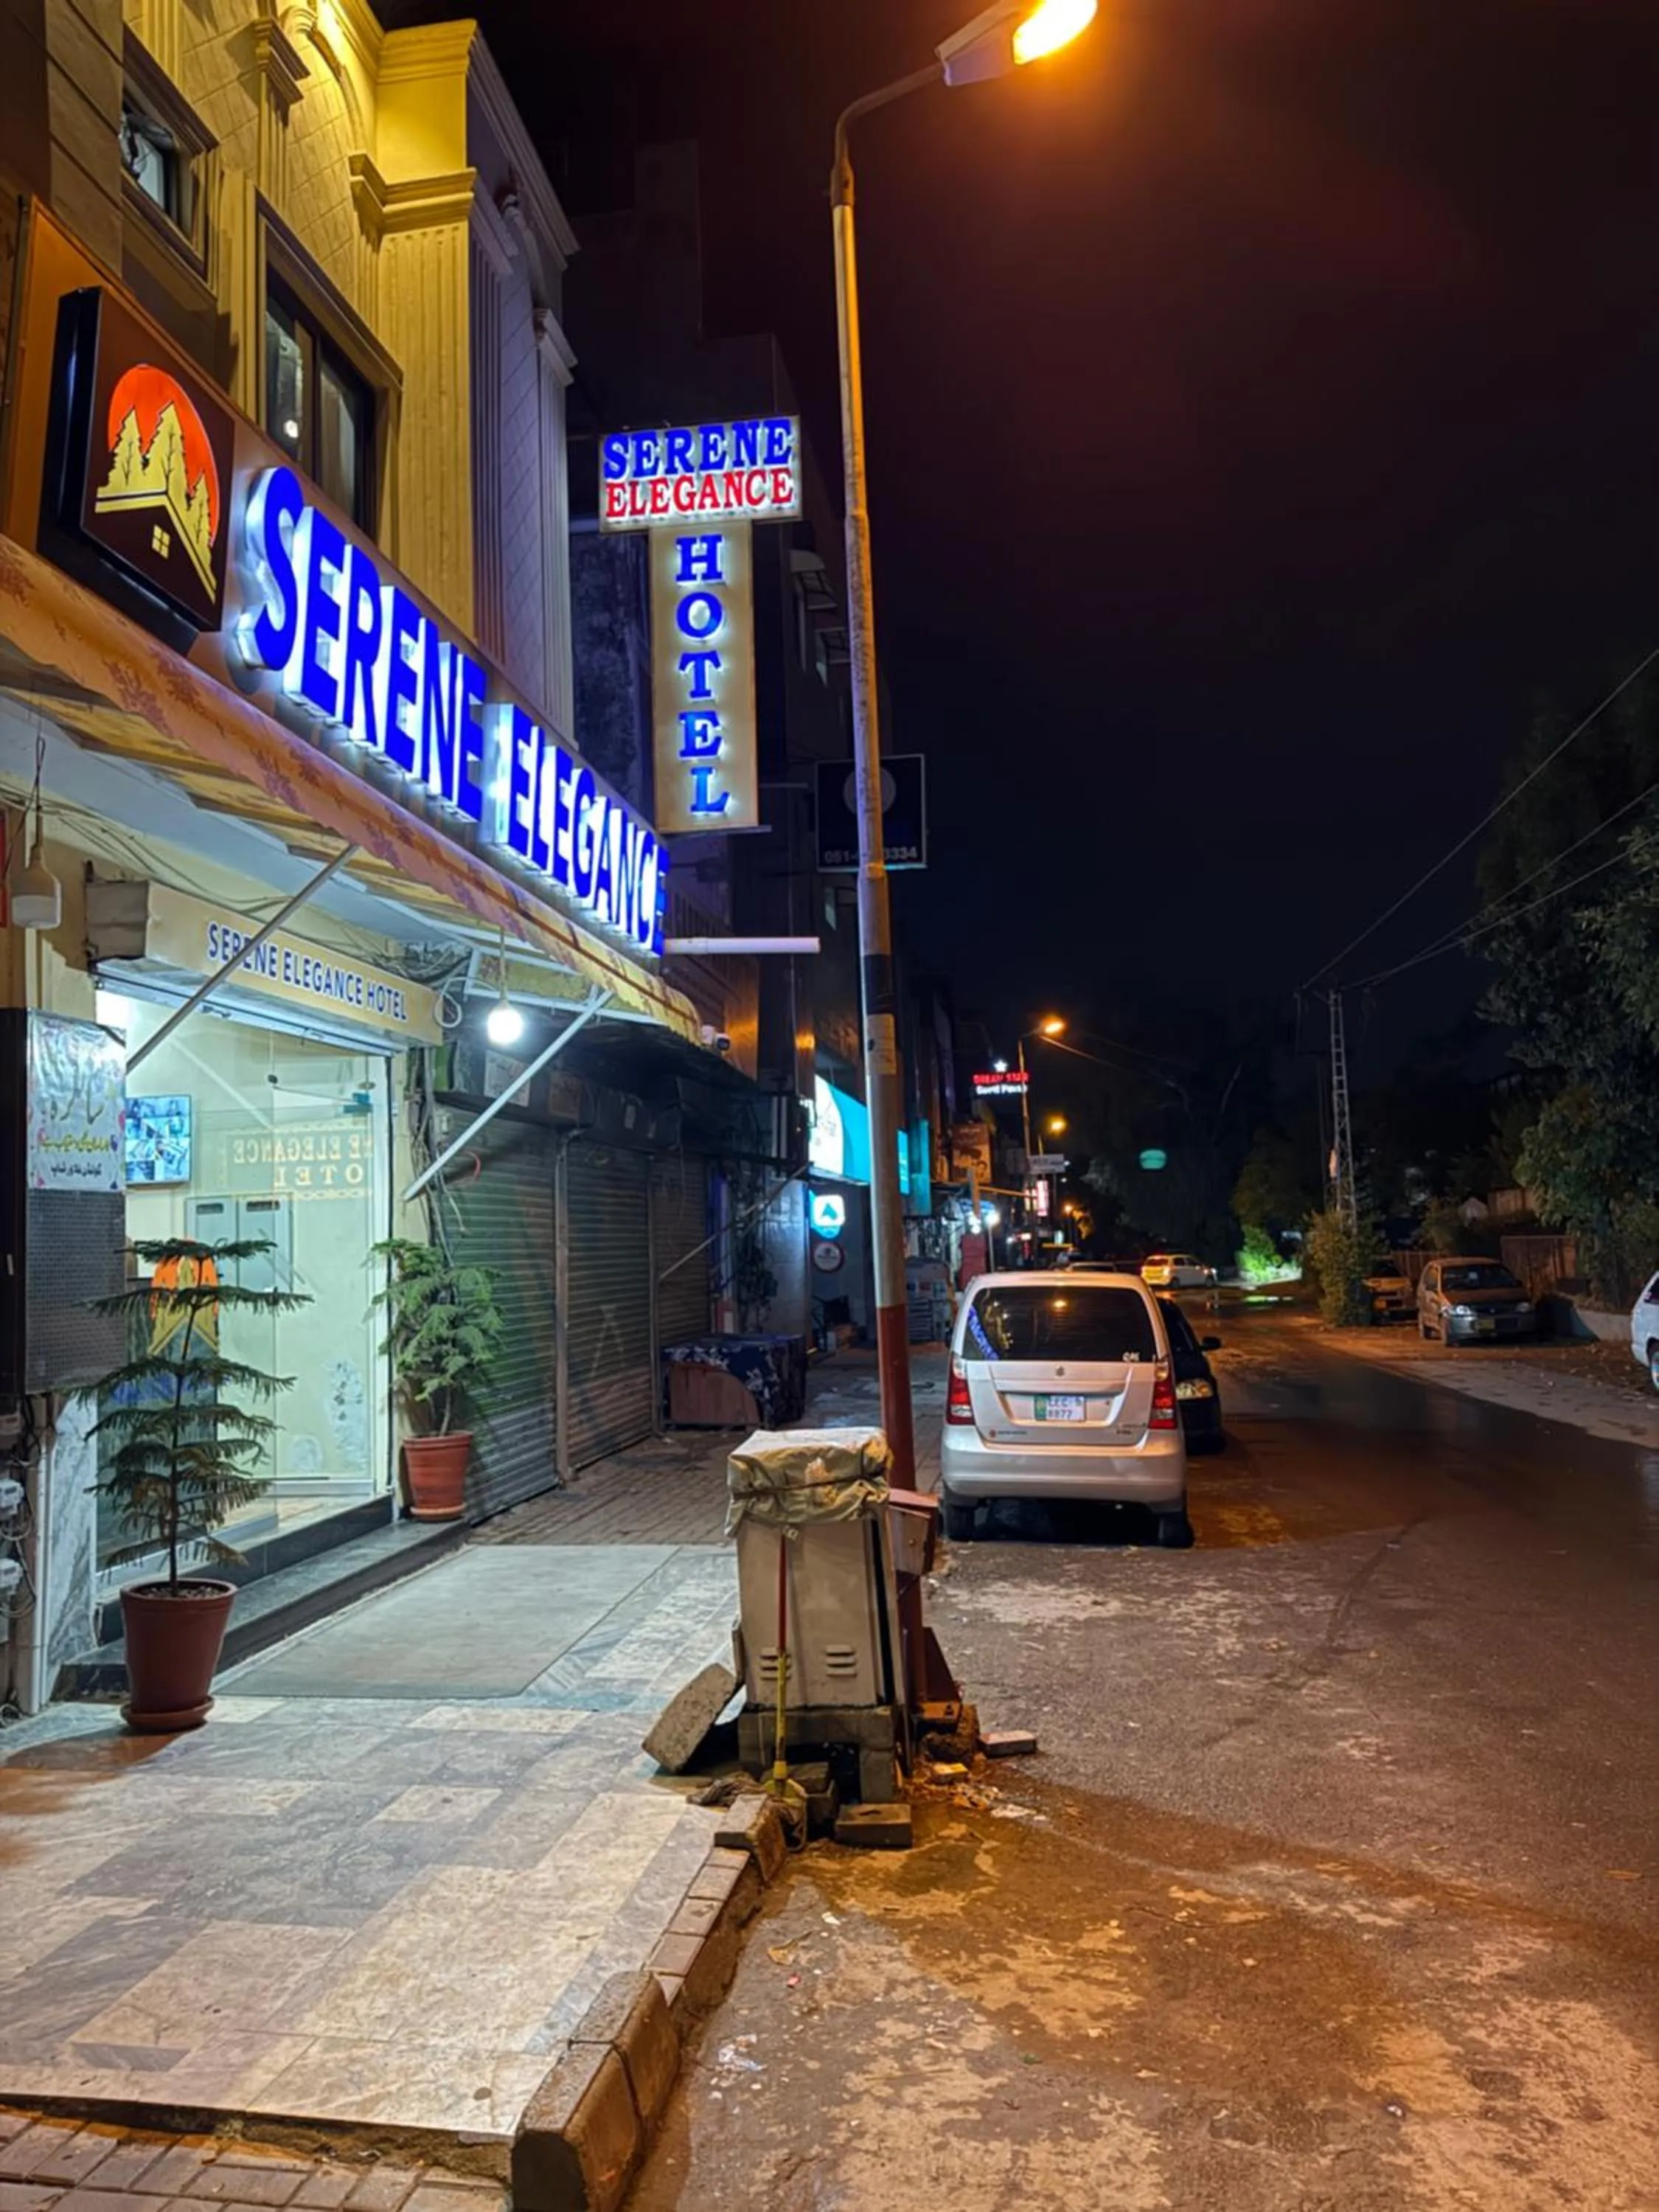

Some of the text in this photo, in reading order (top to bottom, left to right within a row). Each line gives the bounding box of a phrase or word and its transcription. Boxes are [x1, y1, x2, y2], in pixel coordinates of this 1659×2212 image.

[603, 418, 791, 480] SERENE
[605, 467, 793, 518] ELEGANCE
[675, 533, 731, 815] HOTEL
[251, 465, 670, 958] SERENE ELEGANCE
[283, 950, 364, 1006] ELEGANCE
[366, 981, 408, 1020] HOTEL
